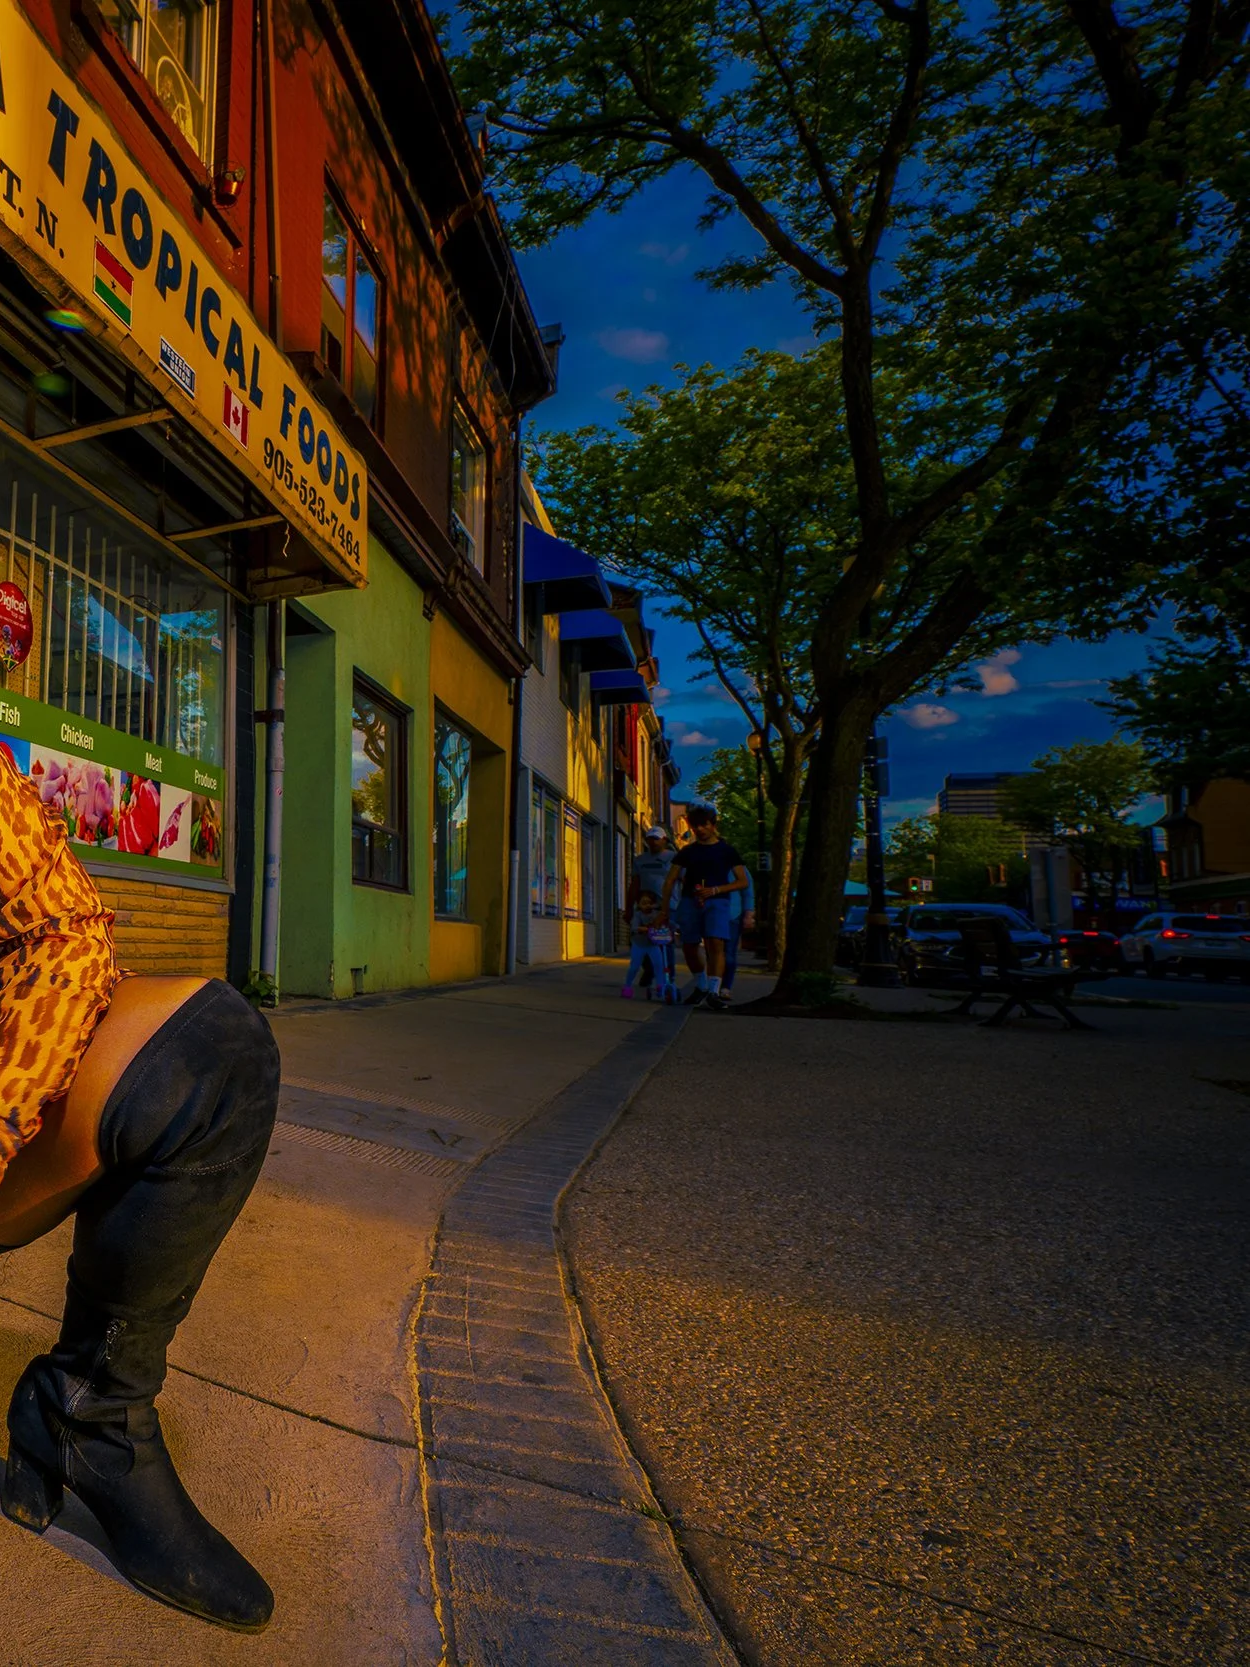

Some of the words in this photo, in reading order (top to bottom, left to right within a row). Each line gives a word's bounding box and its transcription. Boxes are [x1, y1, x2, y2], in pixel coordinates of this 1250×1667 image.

[35, 197, 65, 259] N.
[47, 88, 264, 410] TROPICAL
[280, 383, 361, 521] FOODS
[161, 340, 191, 377] WESTERN
[170, 359, 191, 388] UNION
[263, 437, 361, 566] 905-523-7464
[0, 701, 21, 728] Fish
[60, 723, 94, 751] Chicken
[145, 752, 162, 773] Meat
[194, 769, 217, 791] Produce
